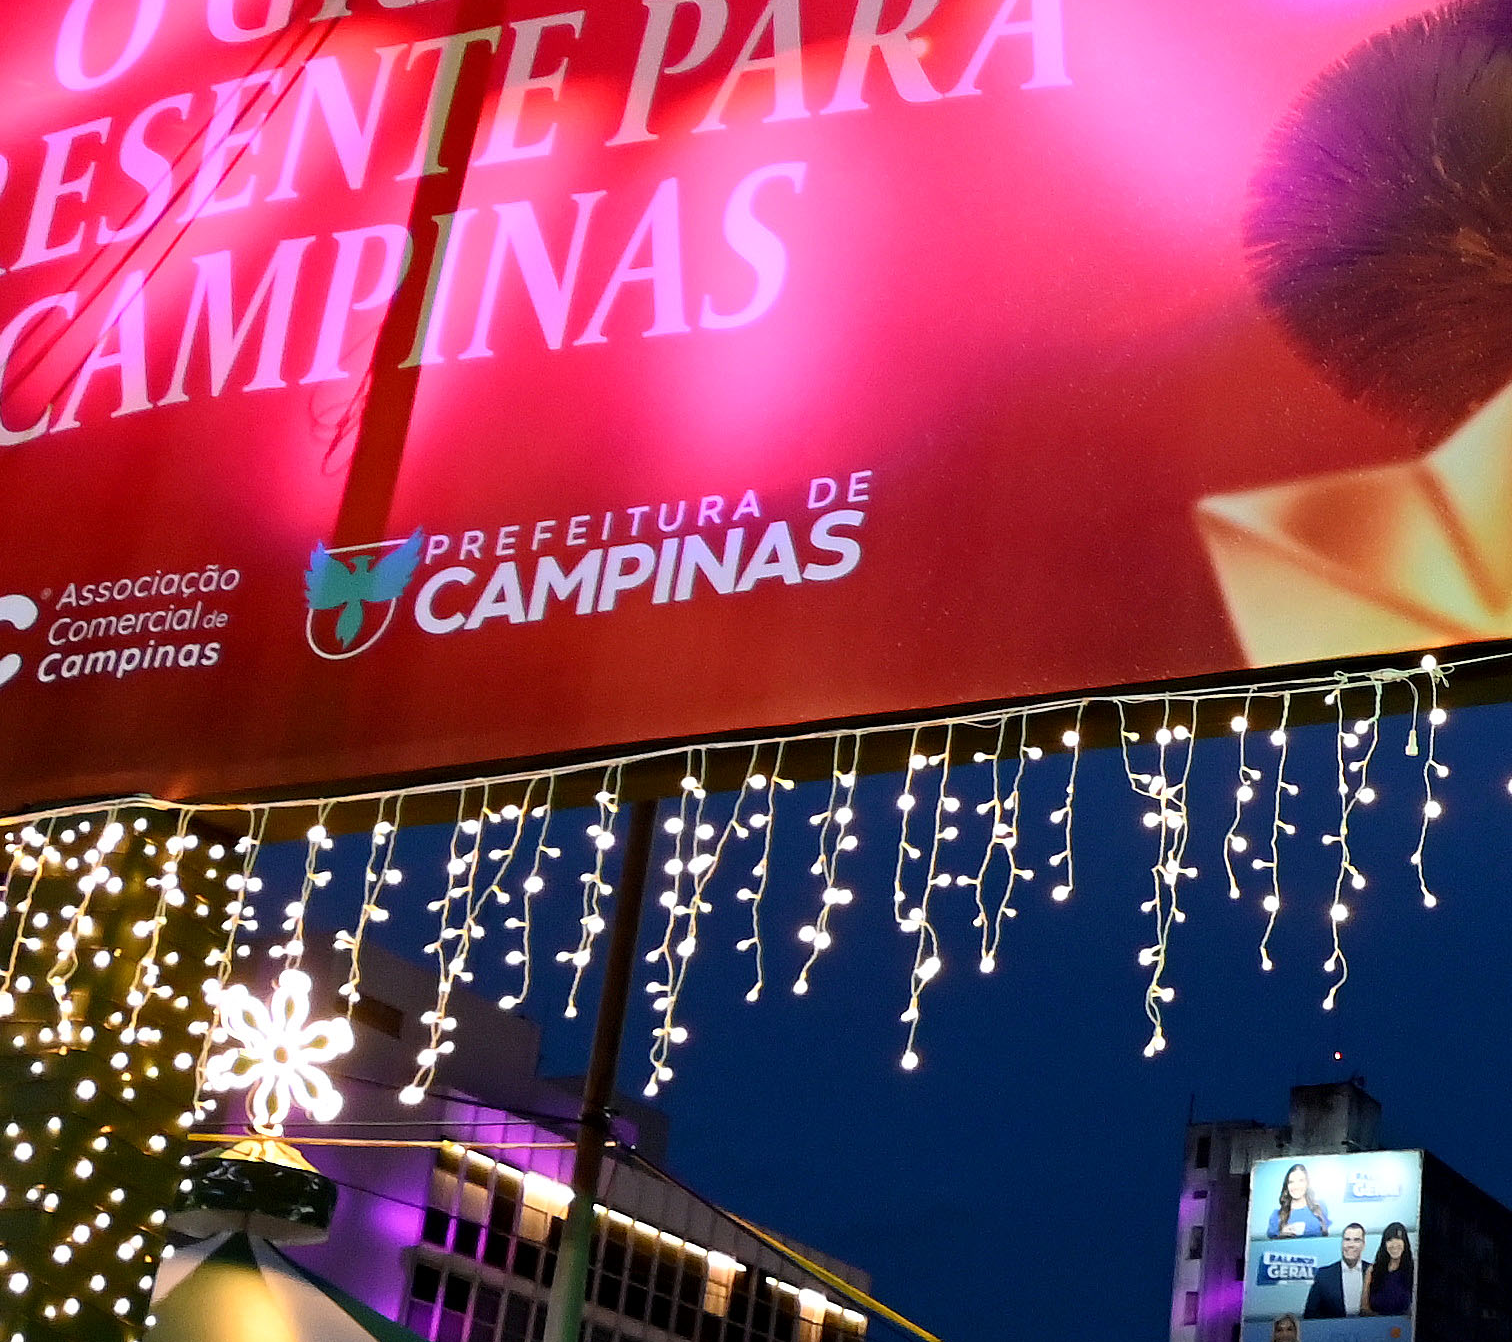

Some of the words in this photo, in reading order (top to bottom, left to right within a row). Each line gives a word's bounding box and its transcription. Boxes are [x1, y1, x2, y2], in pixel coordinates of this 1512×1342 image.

[425, 490, 761, 565] PREFEITURA
[807, 469, 873, 510] DE
[56, 565, 241, 611] Associação
[414, 509, 865, 636] CAMPINAS
[48, 602, 202, 647] Comercial
[202, 609, 231, 630] de
[37, 640, 222, 684] Campinas
[1267, 1264, 1315, 1279] GERAL
